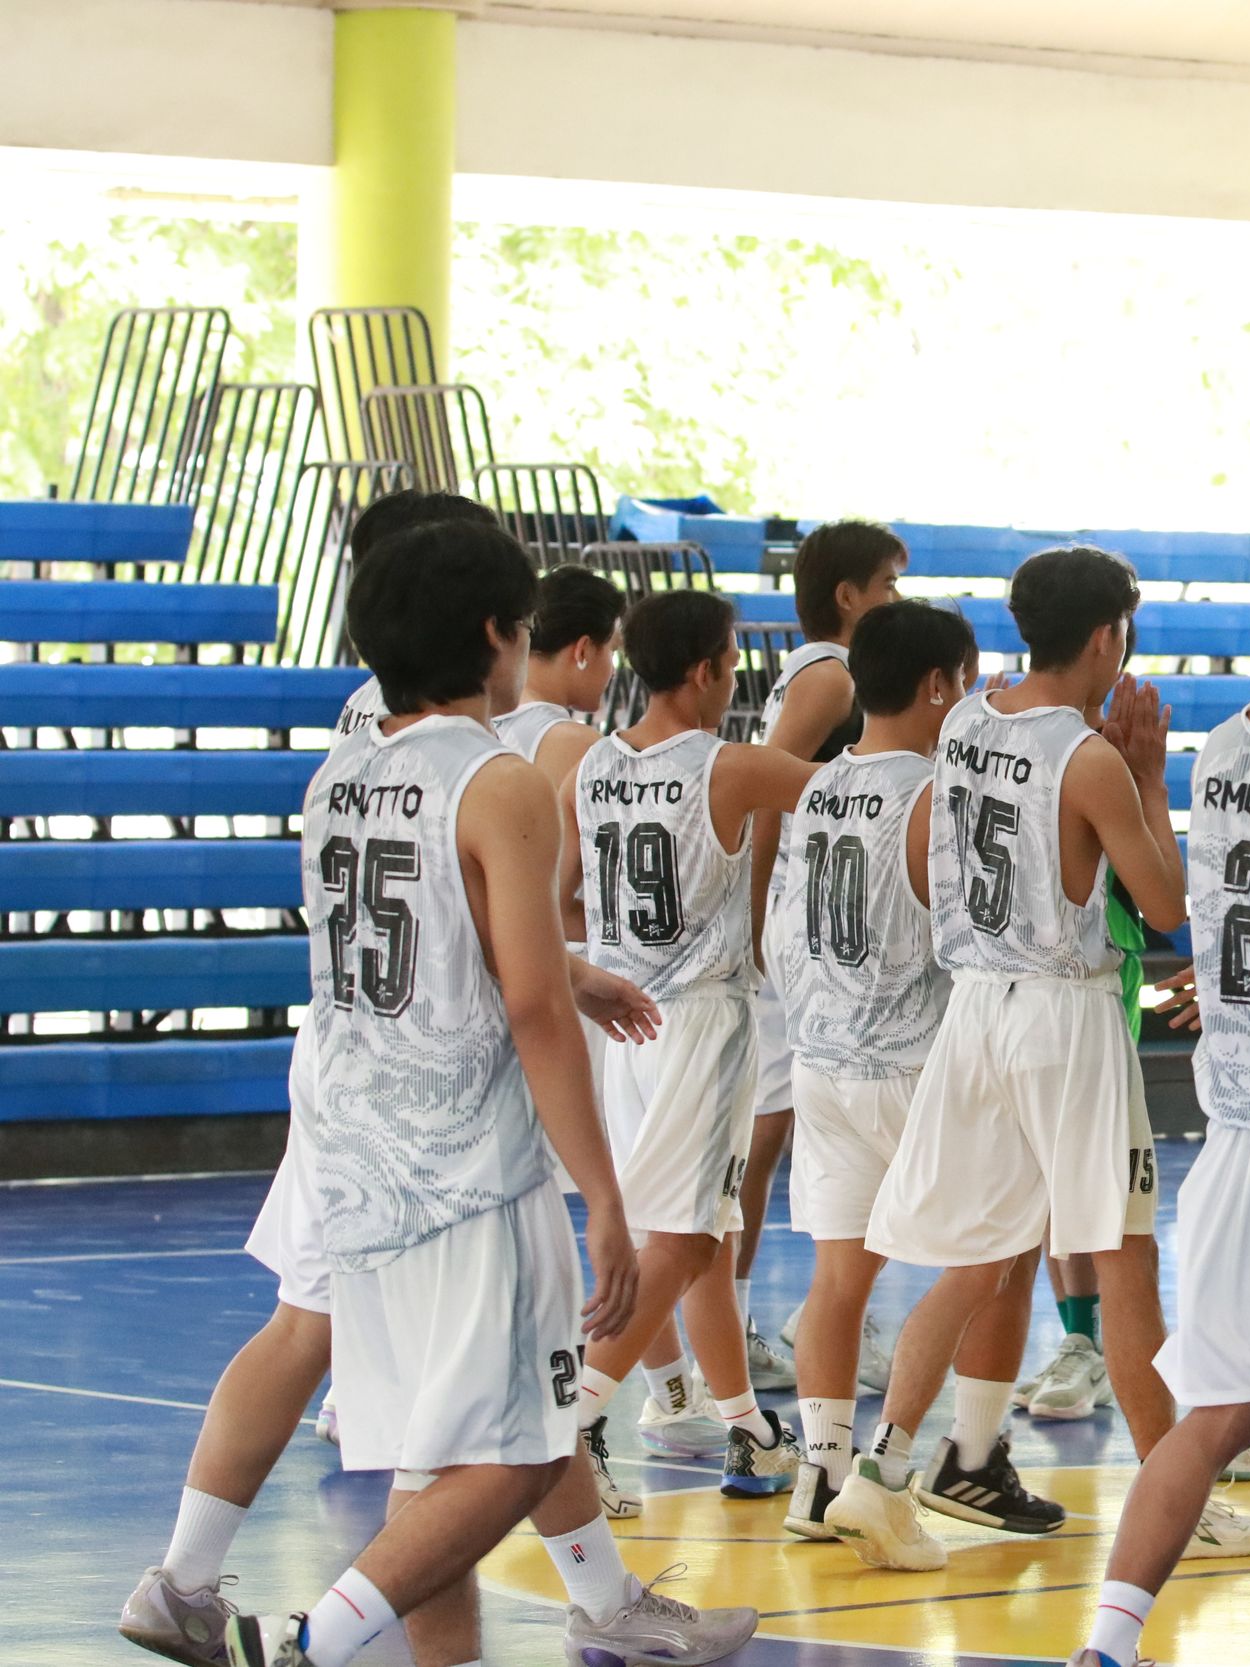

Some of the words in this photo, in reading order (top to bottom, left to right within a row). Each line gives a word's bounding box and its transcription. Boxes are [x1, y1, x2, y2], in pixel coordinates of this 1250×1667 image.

[591, 779, 684, 806] RMUTTO
[806, 790, 884, 820] RMUTTO
[946, 738, 1033, 785] RMUTTO
[594, 821, 686, 946] 19
[805, 831, 870, 968] 10
[948, 785, 1021, 938] 15
[320, 835, 421, 1019] 25
[550, 1344, 586, 1409] 2
